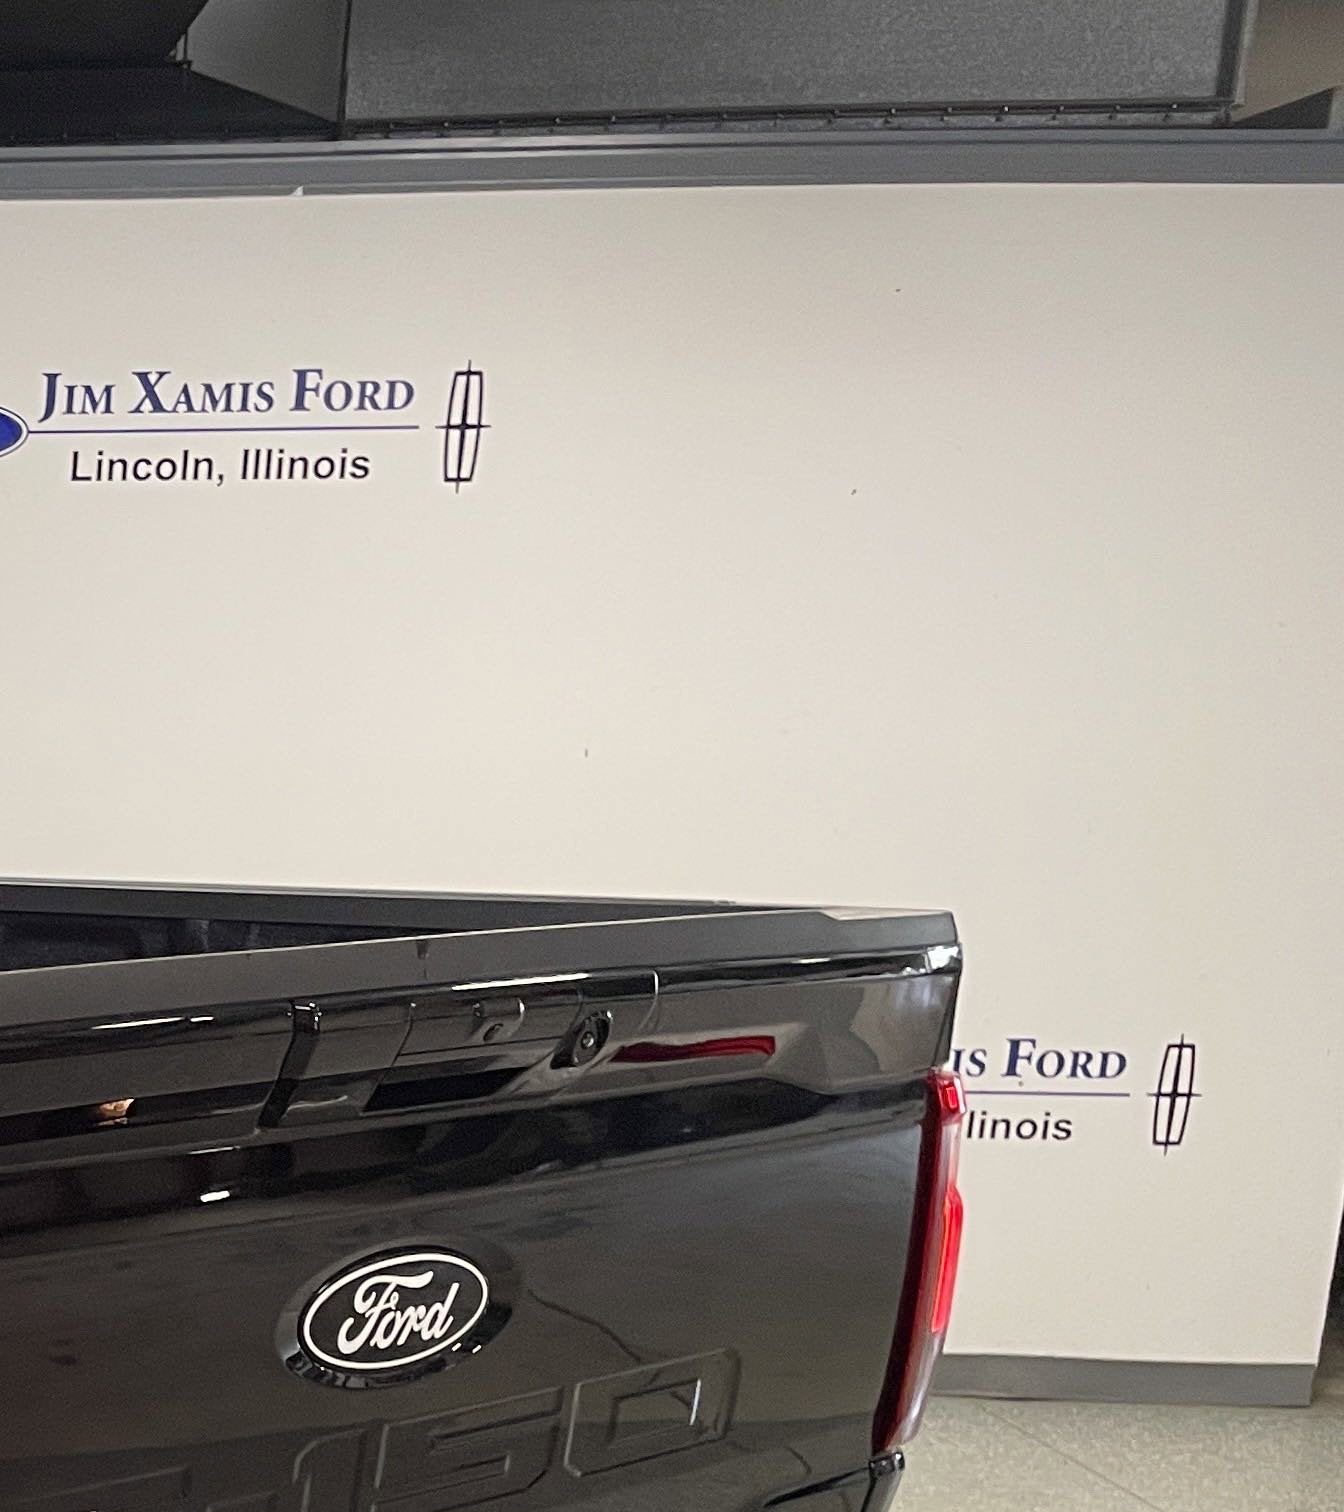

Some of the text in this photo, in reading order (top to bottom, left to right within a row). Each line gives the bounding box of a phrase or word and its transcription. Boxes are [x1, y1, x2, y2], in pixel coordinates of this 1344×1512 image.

[38, 368, 414, 423] JIM XAMIS FORD
[70, 449, 371, 486] Lincoln, Illinois
[1001, 1037, 1127, 1079] FORD
[967, 1110, 1073, 1141] linois
[337, 1270, 460, 1355] Ford
